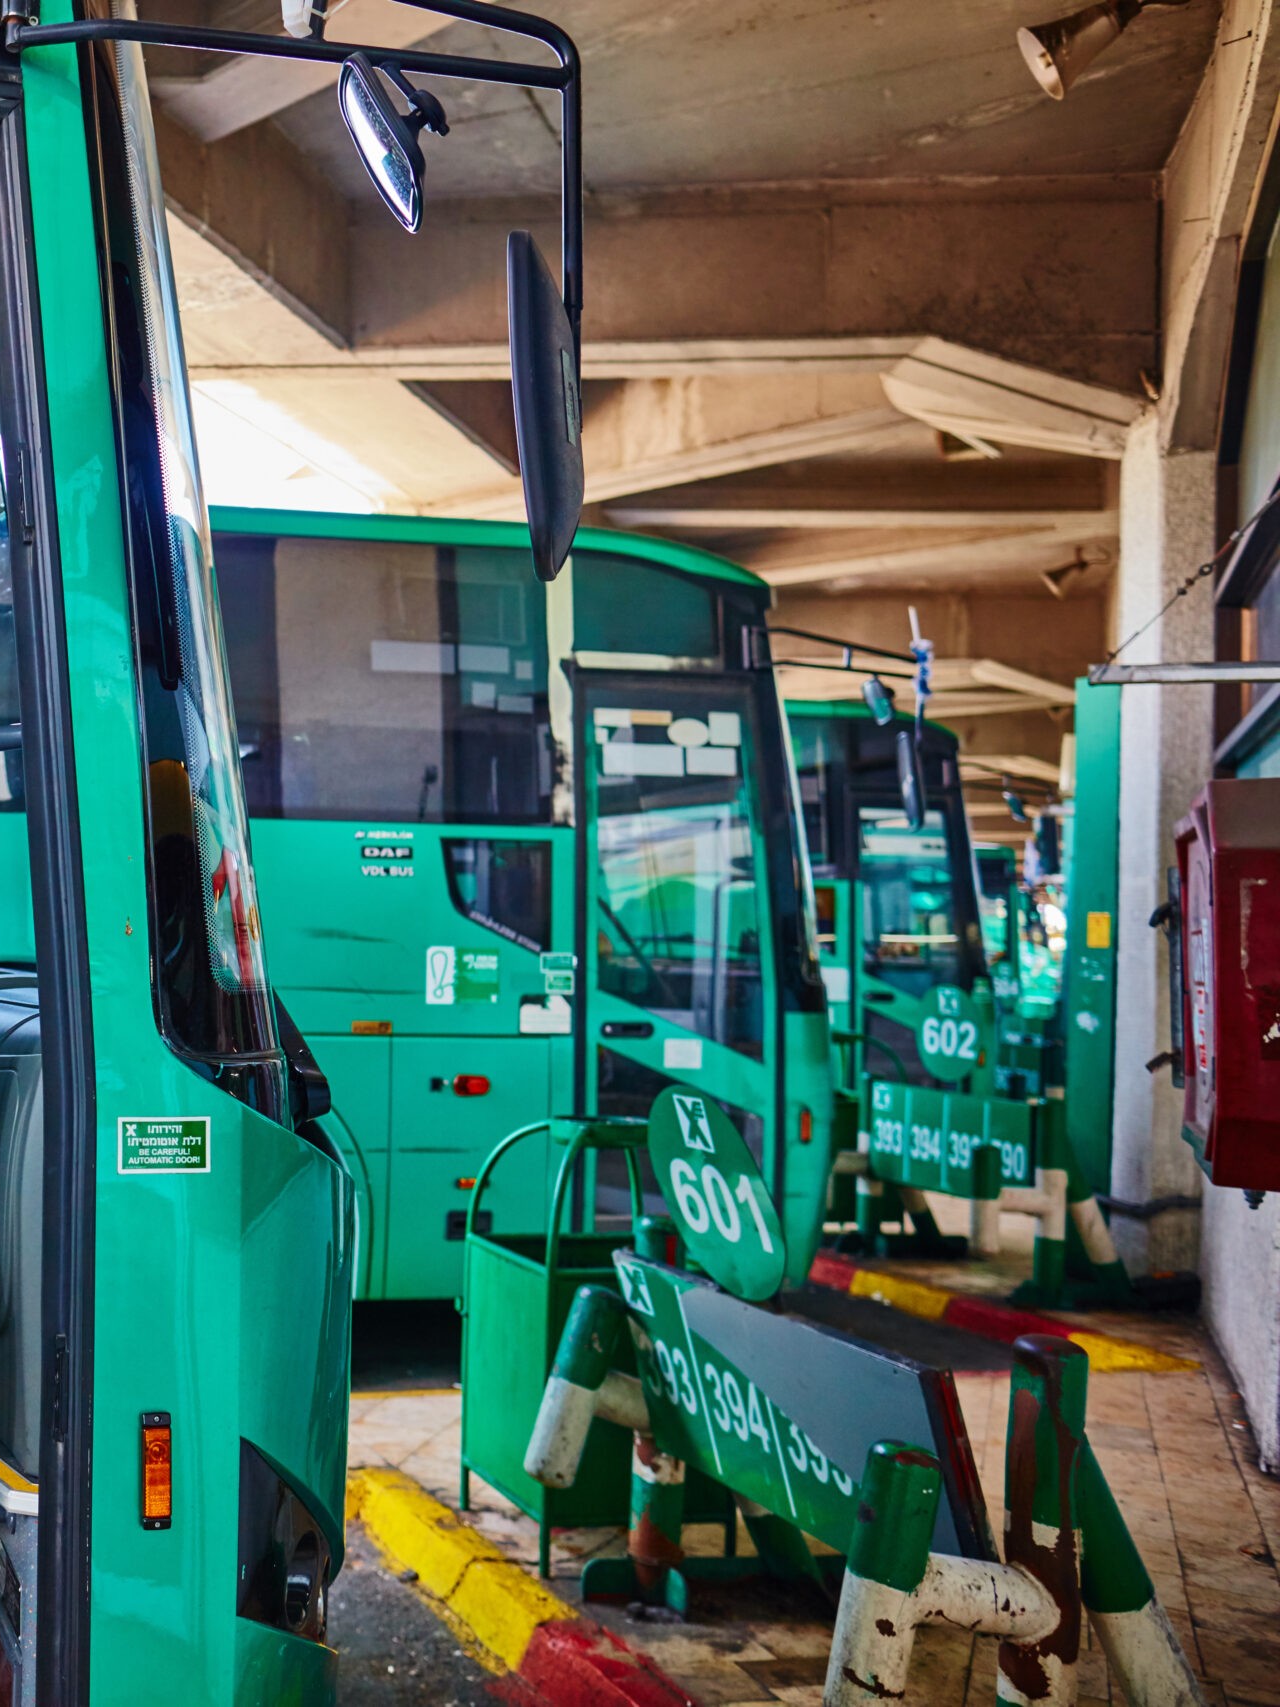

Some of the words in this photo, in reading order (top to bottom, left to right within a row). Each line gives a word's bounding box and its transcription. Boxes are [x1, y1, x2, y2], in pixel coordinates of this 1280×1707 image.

[364, 847, 410, 857] DAF
[389, 866, 414, 876] BUS
[923, 1017, 976, 1060] 602
[182, 1136, 202, 1146] דלת
[874, 1118, 903, 1156] 393
[910, 1124, 940, 1162] 394
[139, 1148, 150, 1156] BE
[151, 1148, 191, 1156] CAREFUL!
[128, 1156, 174, 1165] AUTOMATIC
[175, 1156, 200, 1164] DOOR!
[670, 1158, 774, 1254] 601
[704, 1362, 770, 1454] 394
